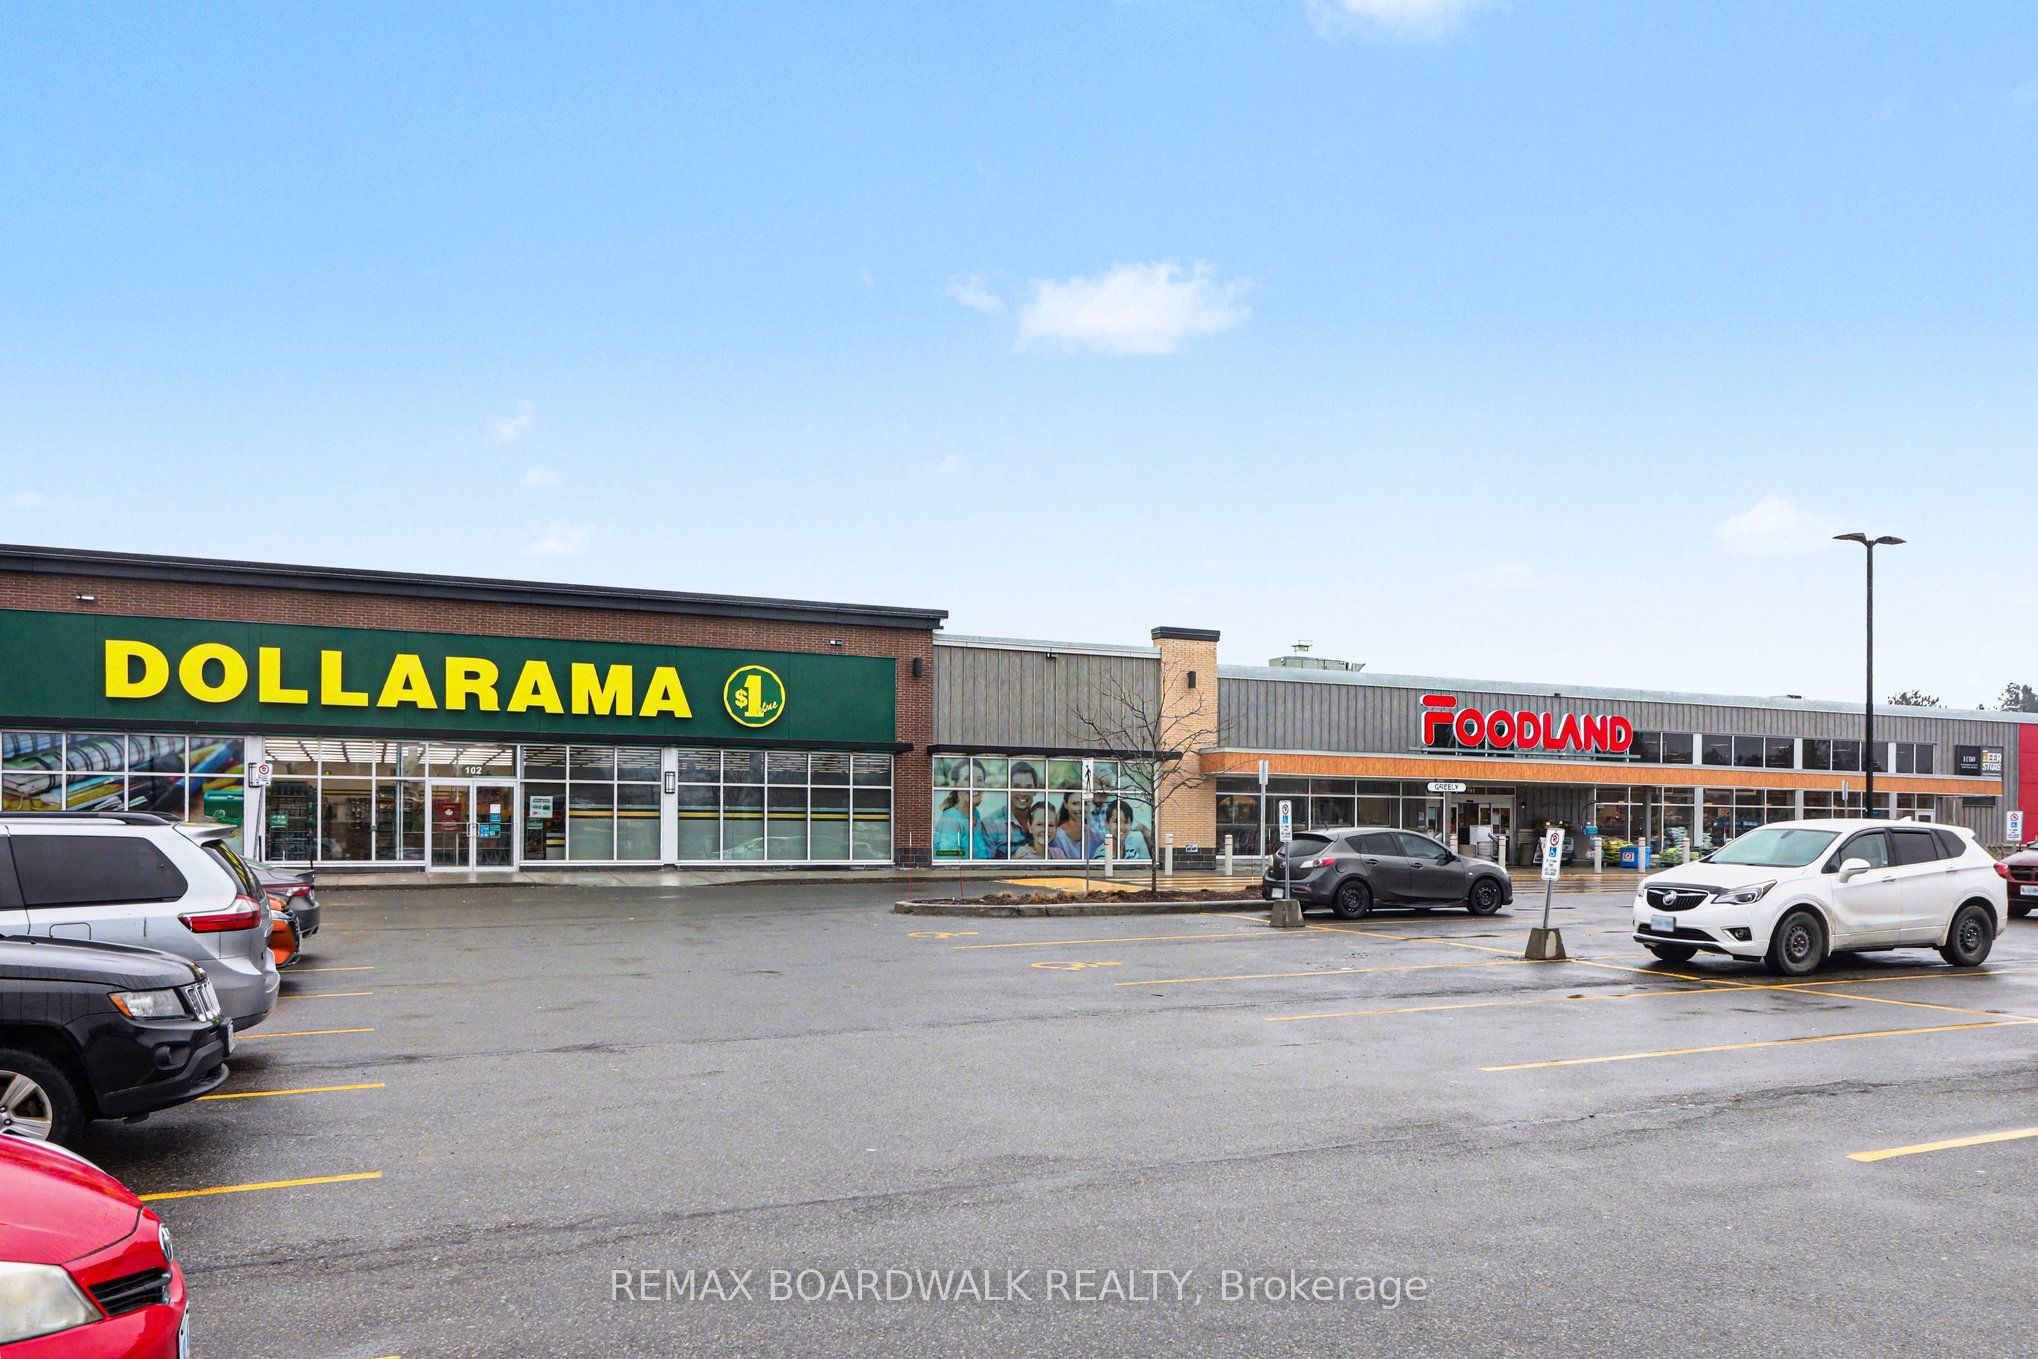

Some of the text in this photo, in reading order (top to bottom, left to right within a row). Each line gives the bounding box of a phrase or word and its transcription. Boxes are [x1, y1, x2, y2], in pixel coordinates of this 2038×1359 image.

[105, 639, 693, 719] DOLLARAMA
[735, 675, 764, 717] $1
[1420, 693, 1634, 753] FOODLAND
[465, 766, 482, 775] 102
